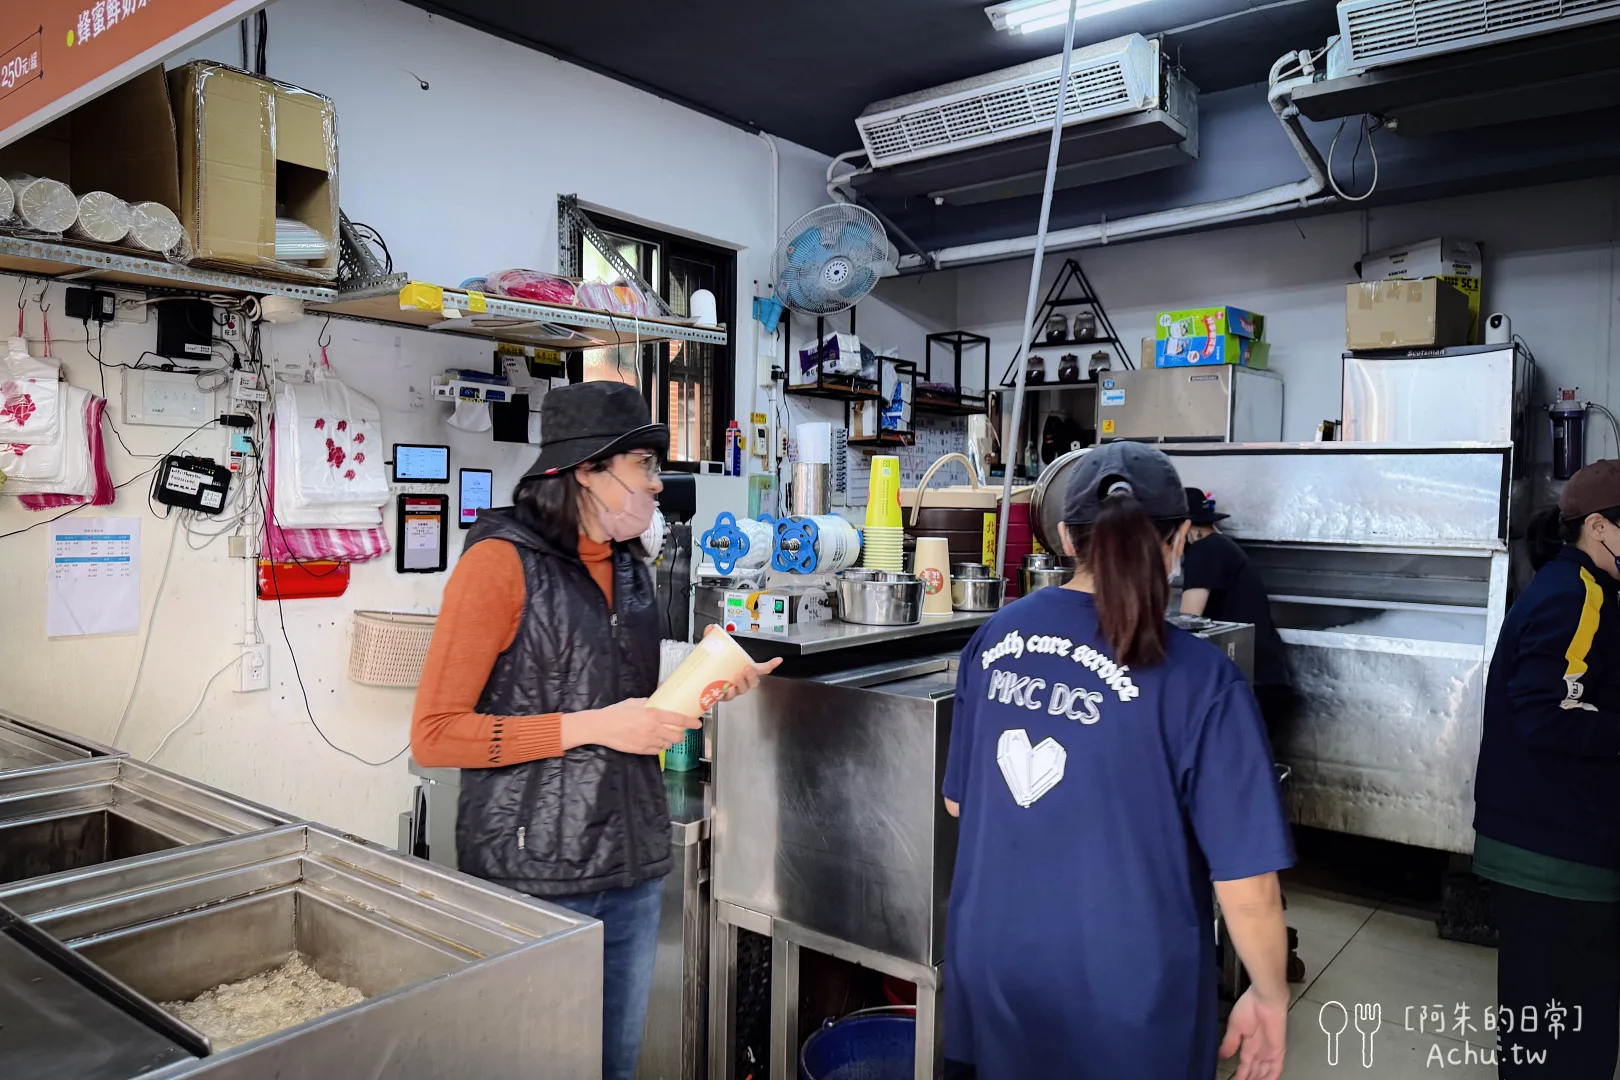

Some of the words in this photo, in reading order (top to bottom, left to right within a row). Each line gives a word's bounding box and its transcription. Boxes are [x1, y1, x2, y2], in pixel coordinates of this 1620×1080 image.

[77, 0, 151, 45] 蜂蜜鮮奶
[1461, 278, 1472, 288] SC
[1026, 634, 1073, 657] care
[988, 669, 1046, 710] MKC
[1047, 682, 1104, 725] DCS
